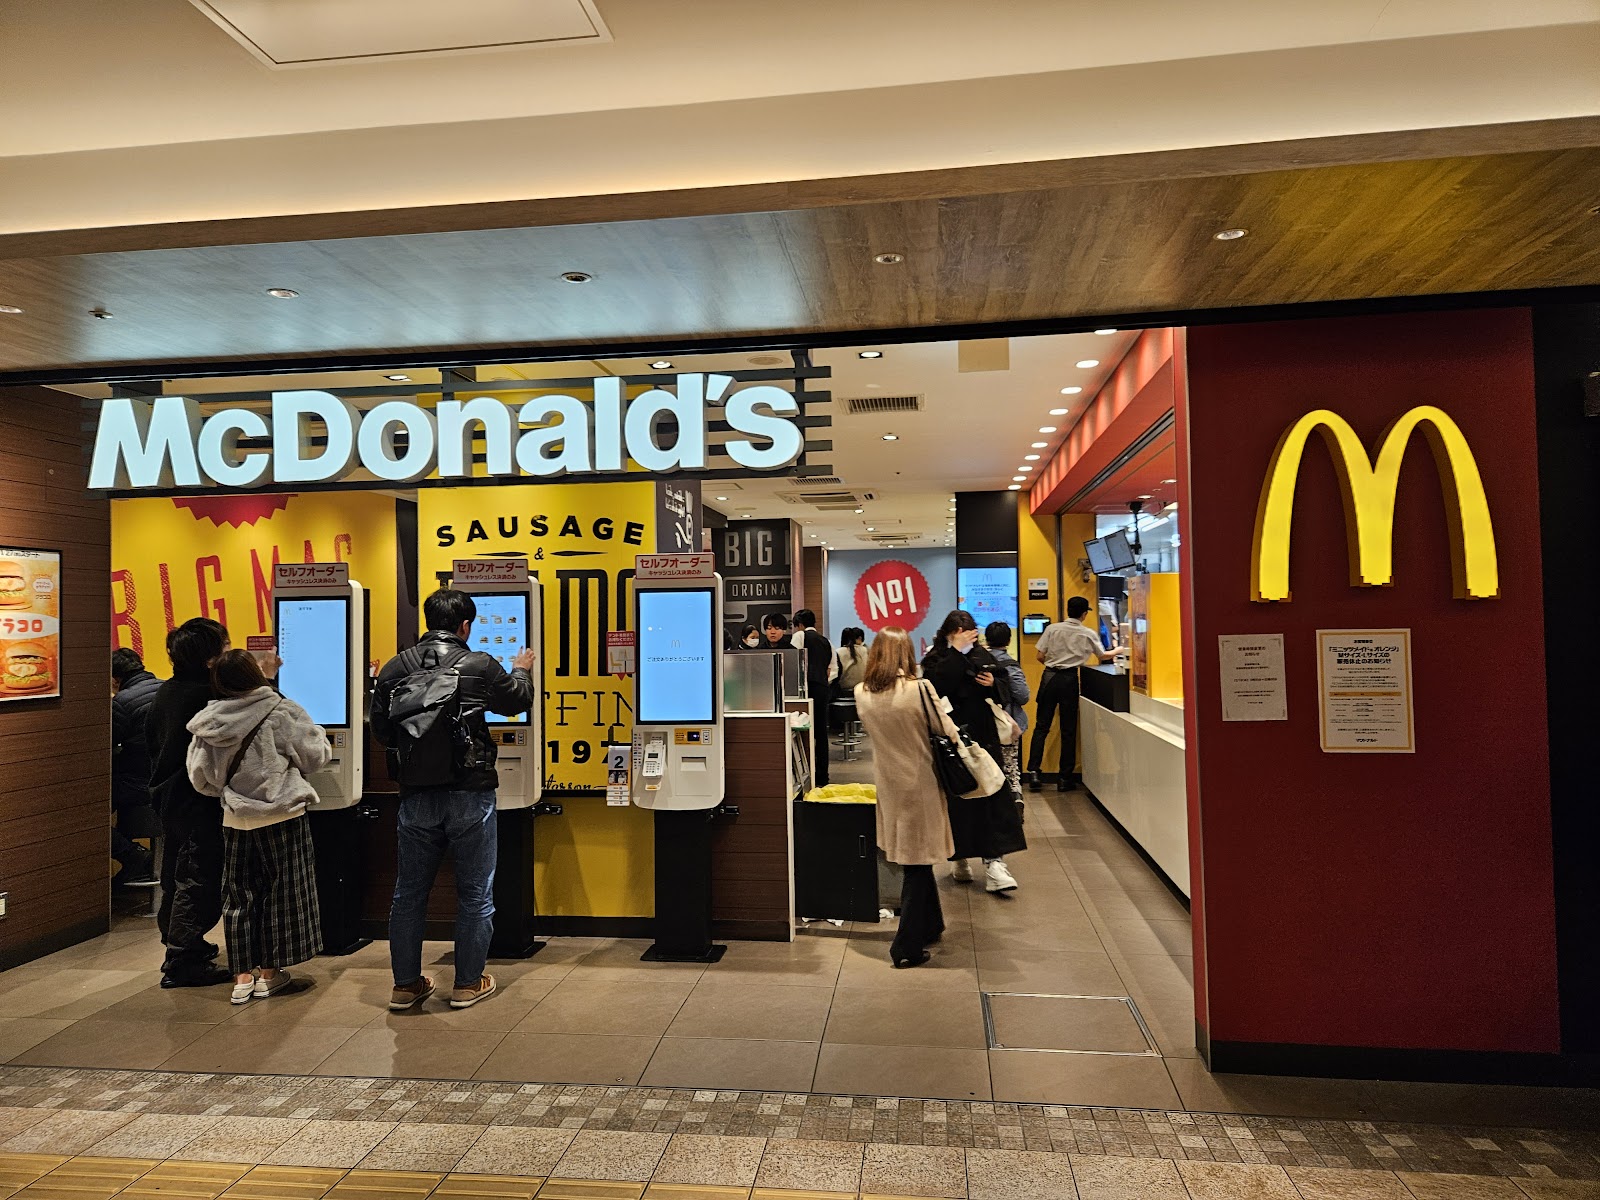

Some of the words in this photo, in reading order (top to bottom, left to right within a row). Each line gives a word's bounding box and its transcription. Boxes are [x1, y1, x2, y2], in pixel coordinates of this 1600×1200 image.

[88, 373, 803, 490] McDonald's
[436, 514, 645, 547] SAUSAGE
[534, 547, 545, 560] &
[725, 531, 773, 566] BIG
[457, 562, 524, 573] セルフオーダー
[640, 557, 710, 568] セルフオーダー
[279, 566, 345, 577] セルフオーダー
[0, 618, 43, 635] ラコロ
[613, 755, 624, 769] 2
